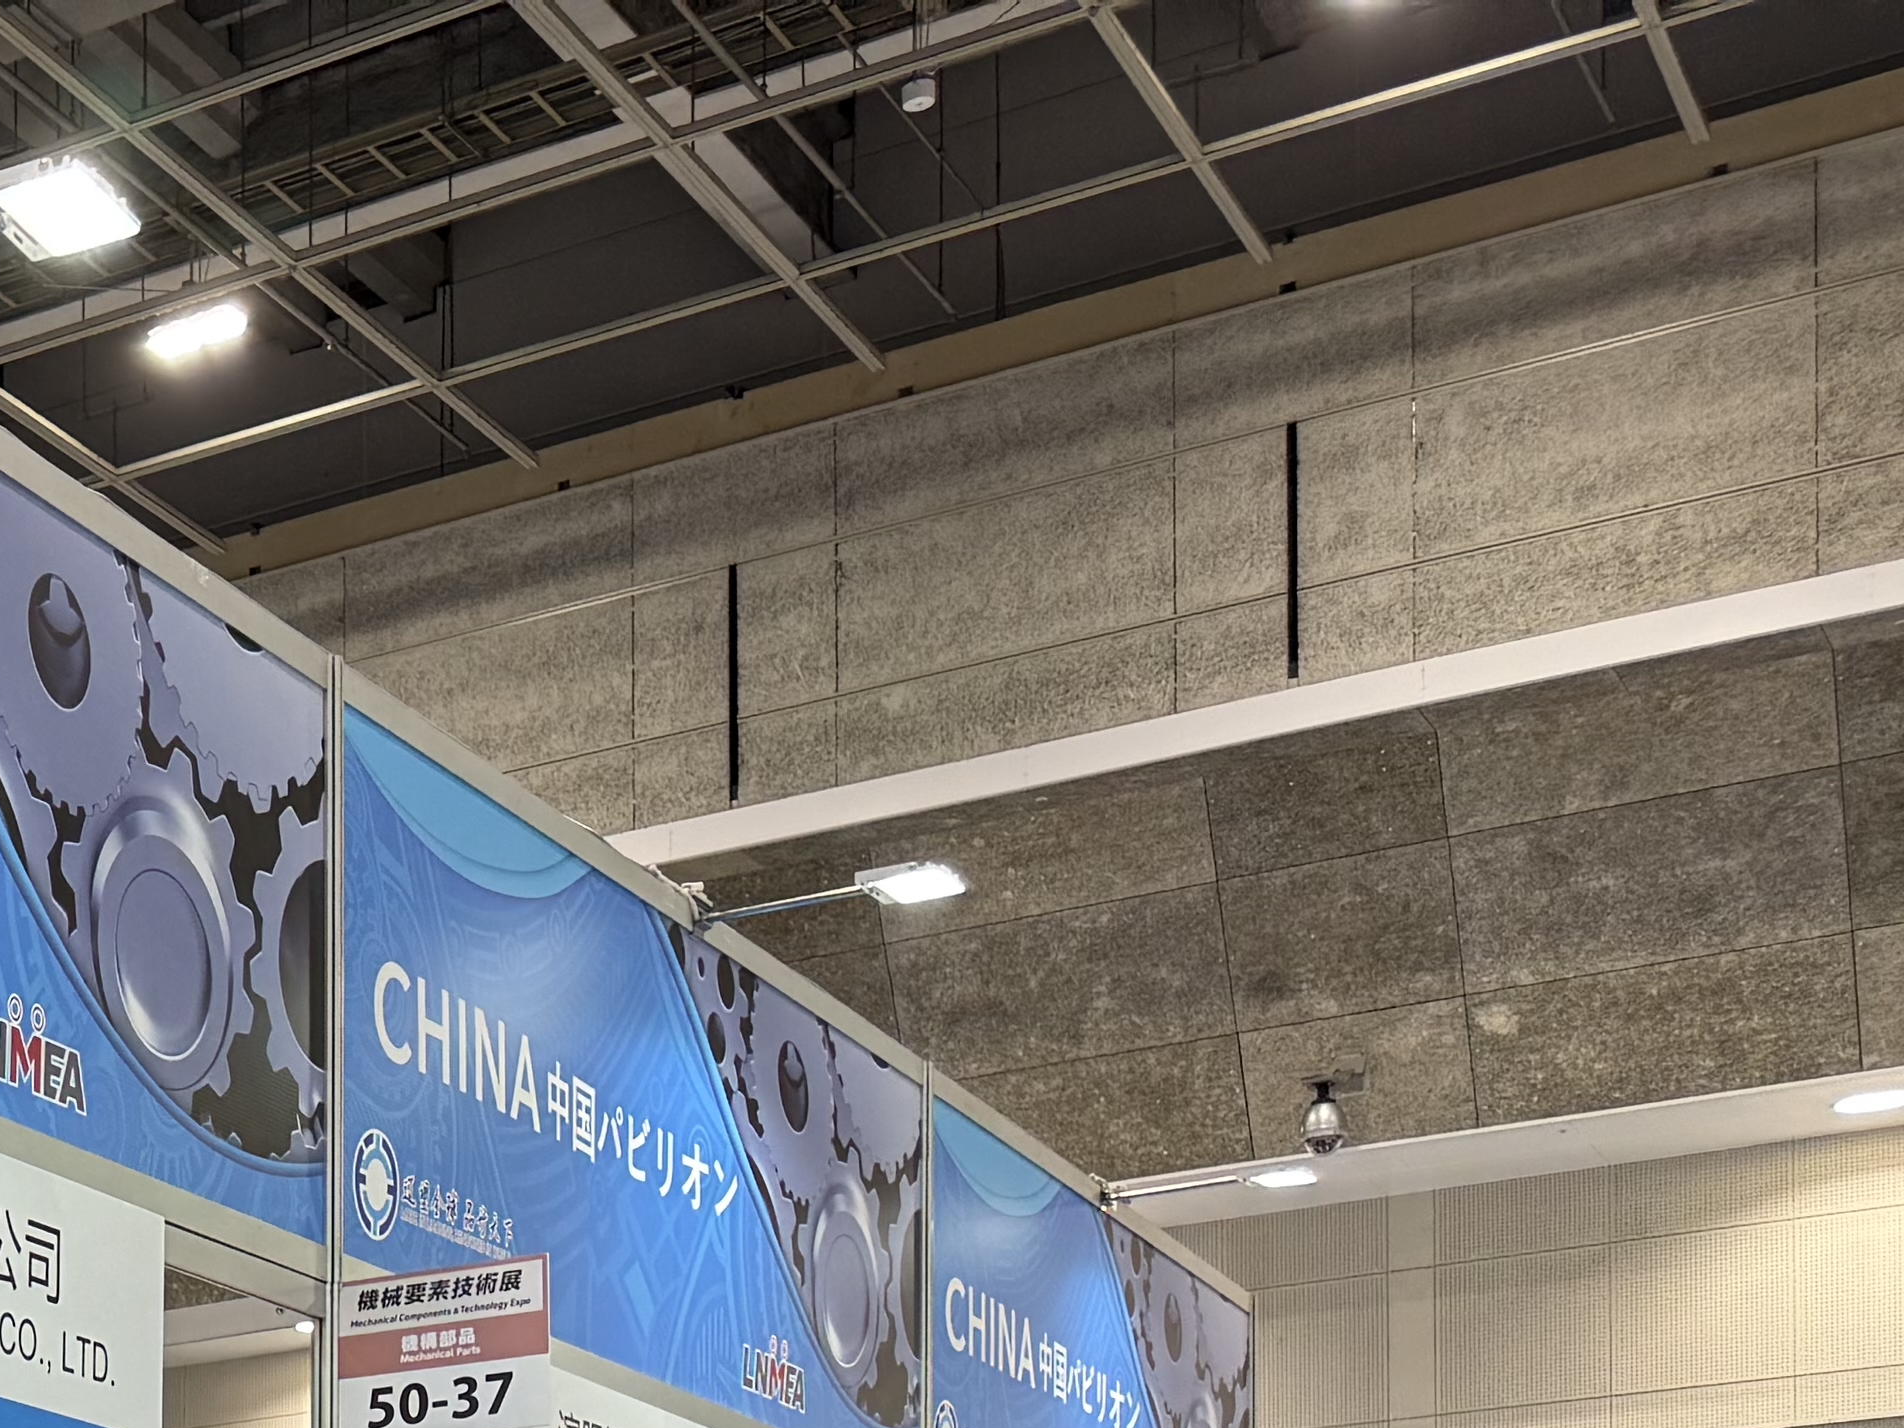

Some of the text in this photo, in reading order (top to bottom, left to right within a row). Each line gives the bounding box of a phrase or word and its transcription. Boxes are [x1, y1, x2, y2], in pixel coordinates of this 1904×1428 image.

[373, 960, 541, 1134] CHINA
[547, 1060, 738, 1217] 中国パビリオン
[351, 1313, 397, 1328] Mechanical
[399, 1307, 451, 1322] Components
[461, 1300, 508, 1315] Technology
[357, 1270, 523, 1312] 機械要素技術展
[61, 1334, 117, 1388] LTD.
[400, 1346, 480, 1364] Mechanical Parts
[401, 1328, 475, 1351] 機構部品
[945, 1277, 1036, 1391] CHINA
[368, 1371, 514, 1428] 50-37
